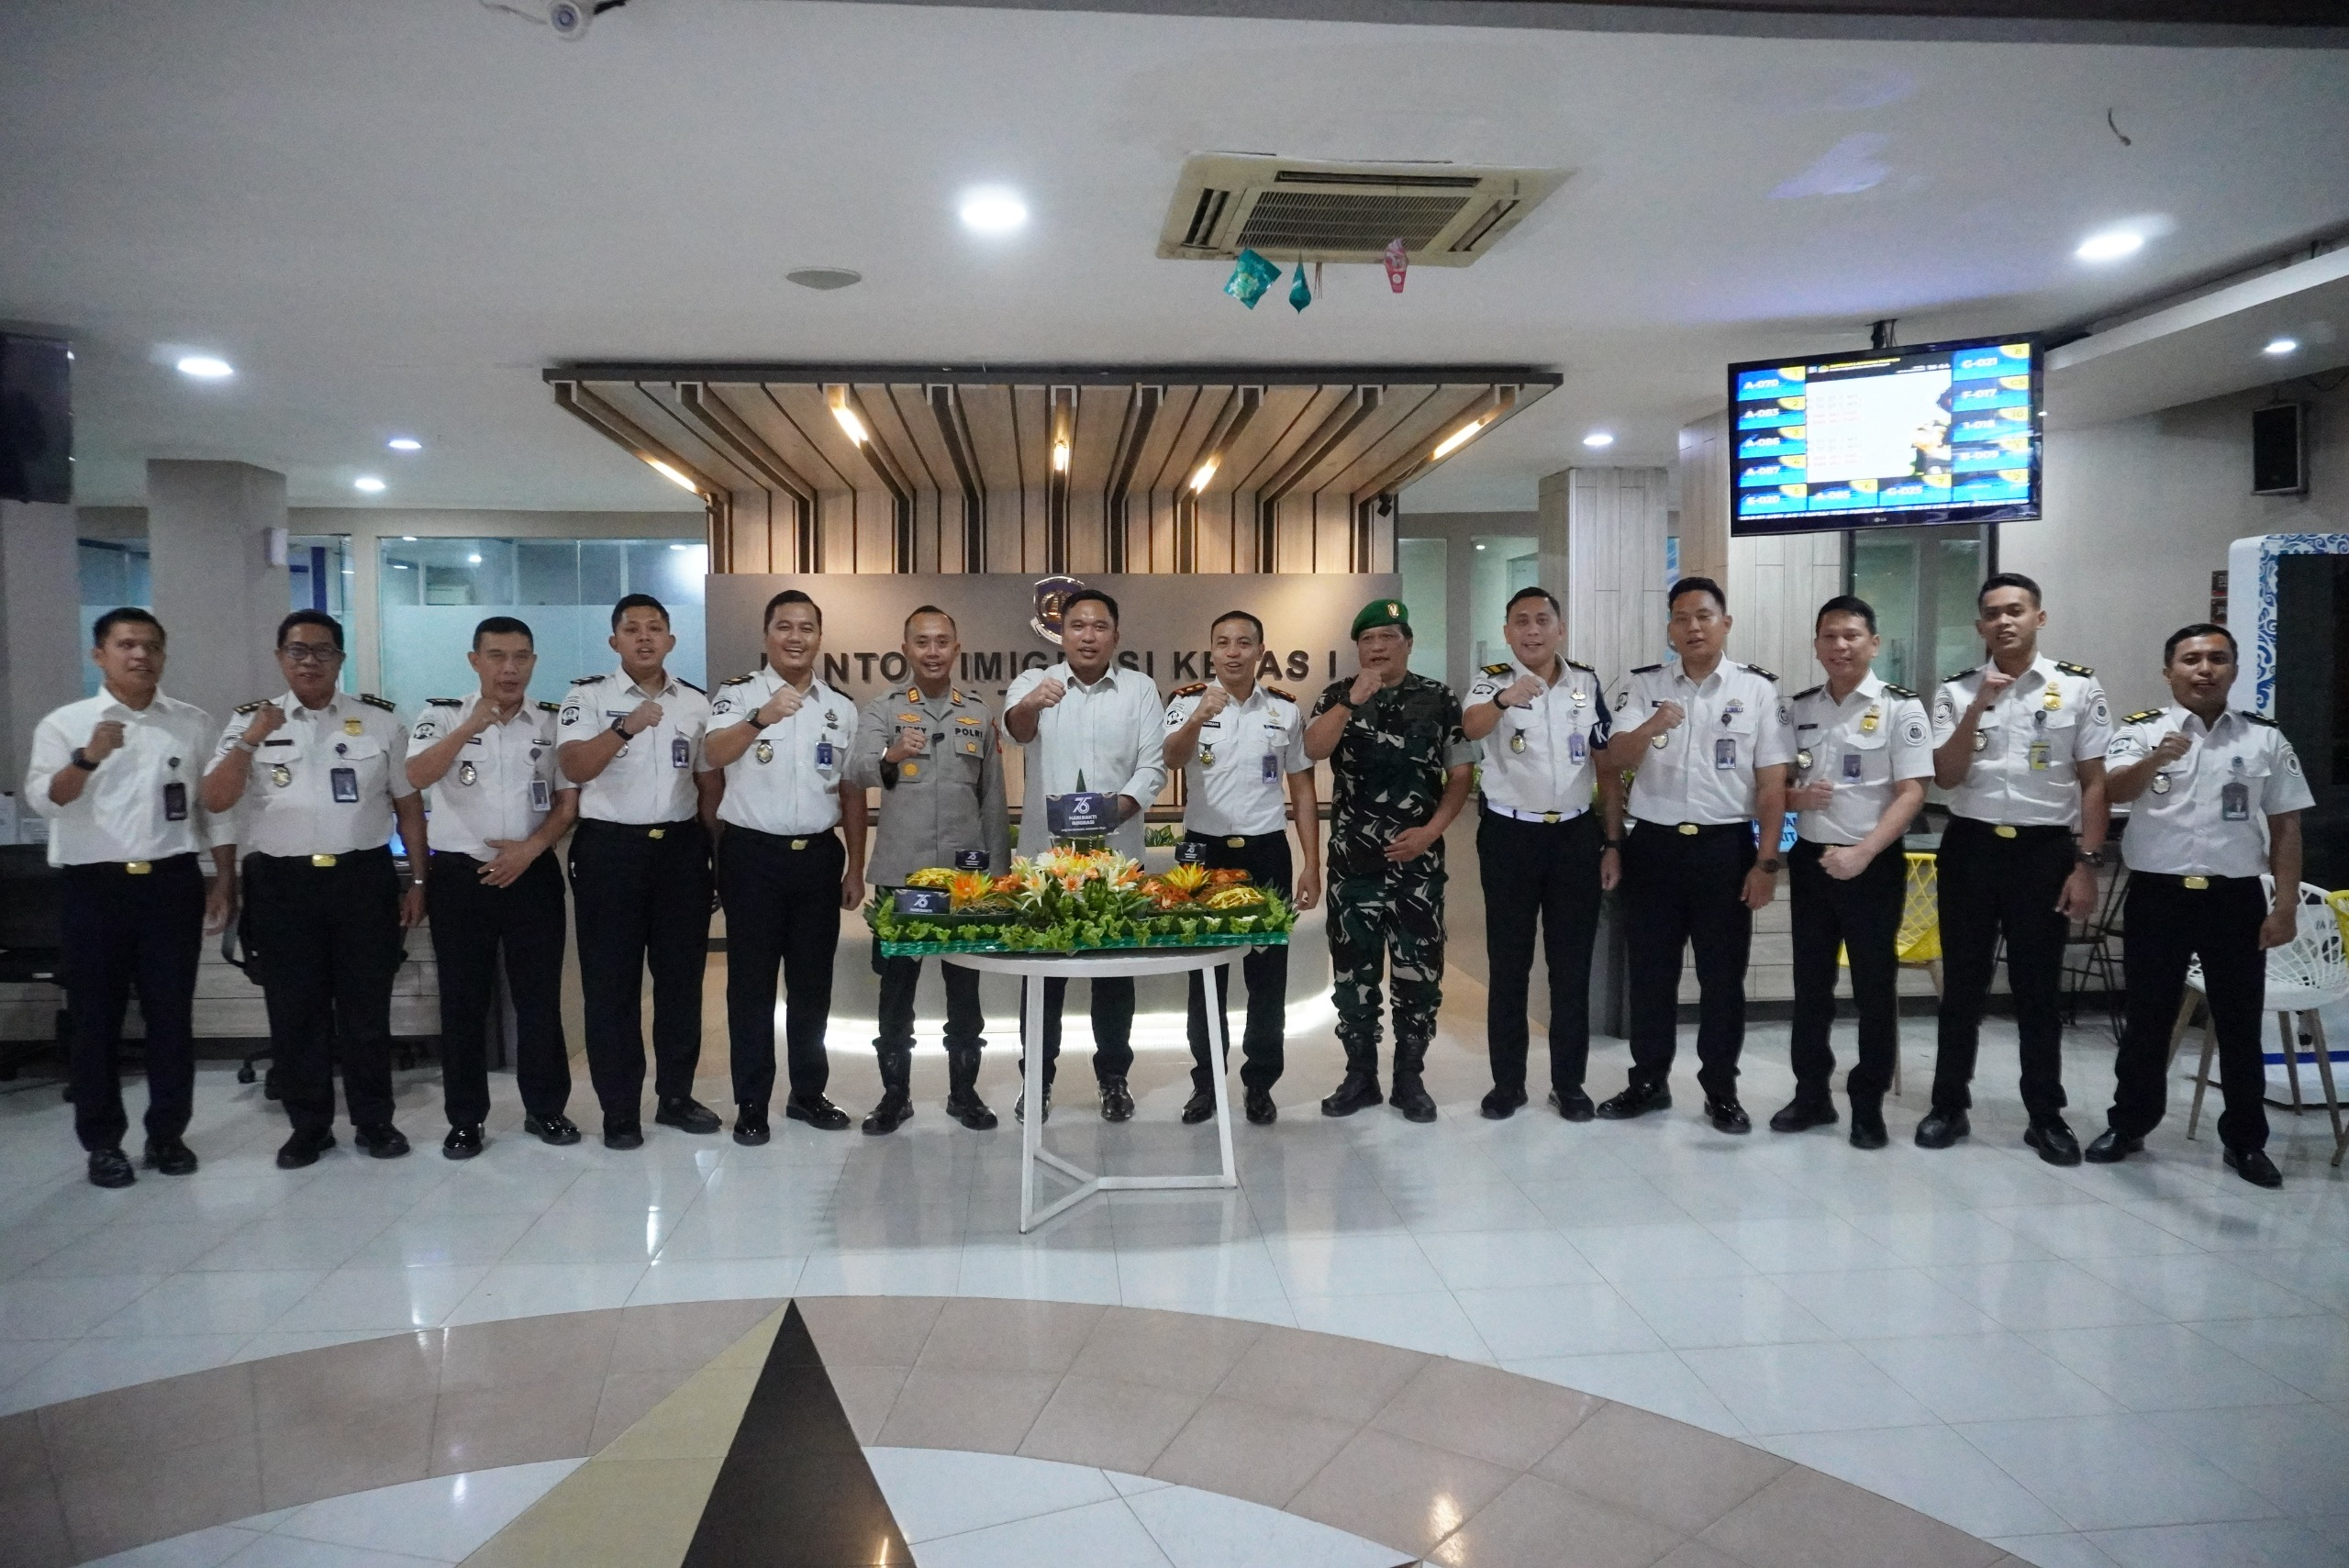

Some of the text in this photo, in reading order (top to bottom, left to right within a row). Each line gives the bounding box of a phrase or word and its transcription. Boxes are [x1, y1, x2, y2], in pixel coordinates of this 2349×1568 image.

[1174, 651, 1309, 681] KEAS
[1329, 651, 1337, 680] I
[955, 728, 983, 738] POLRI
[1073, 796, 1093, 815] 76
